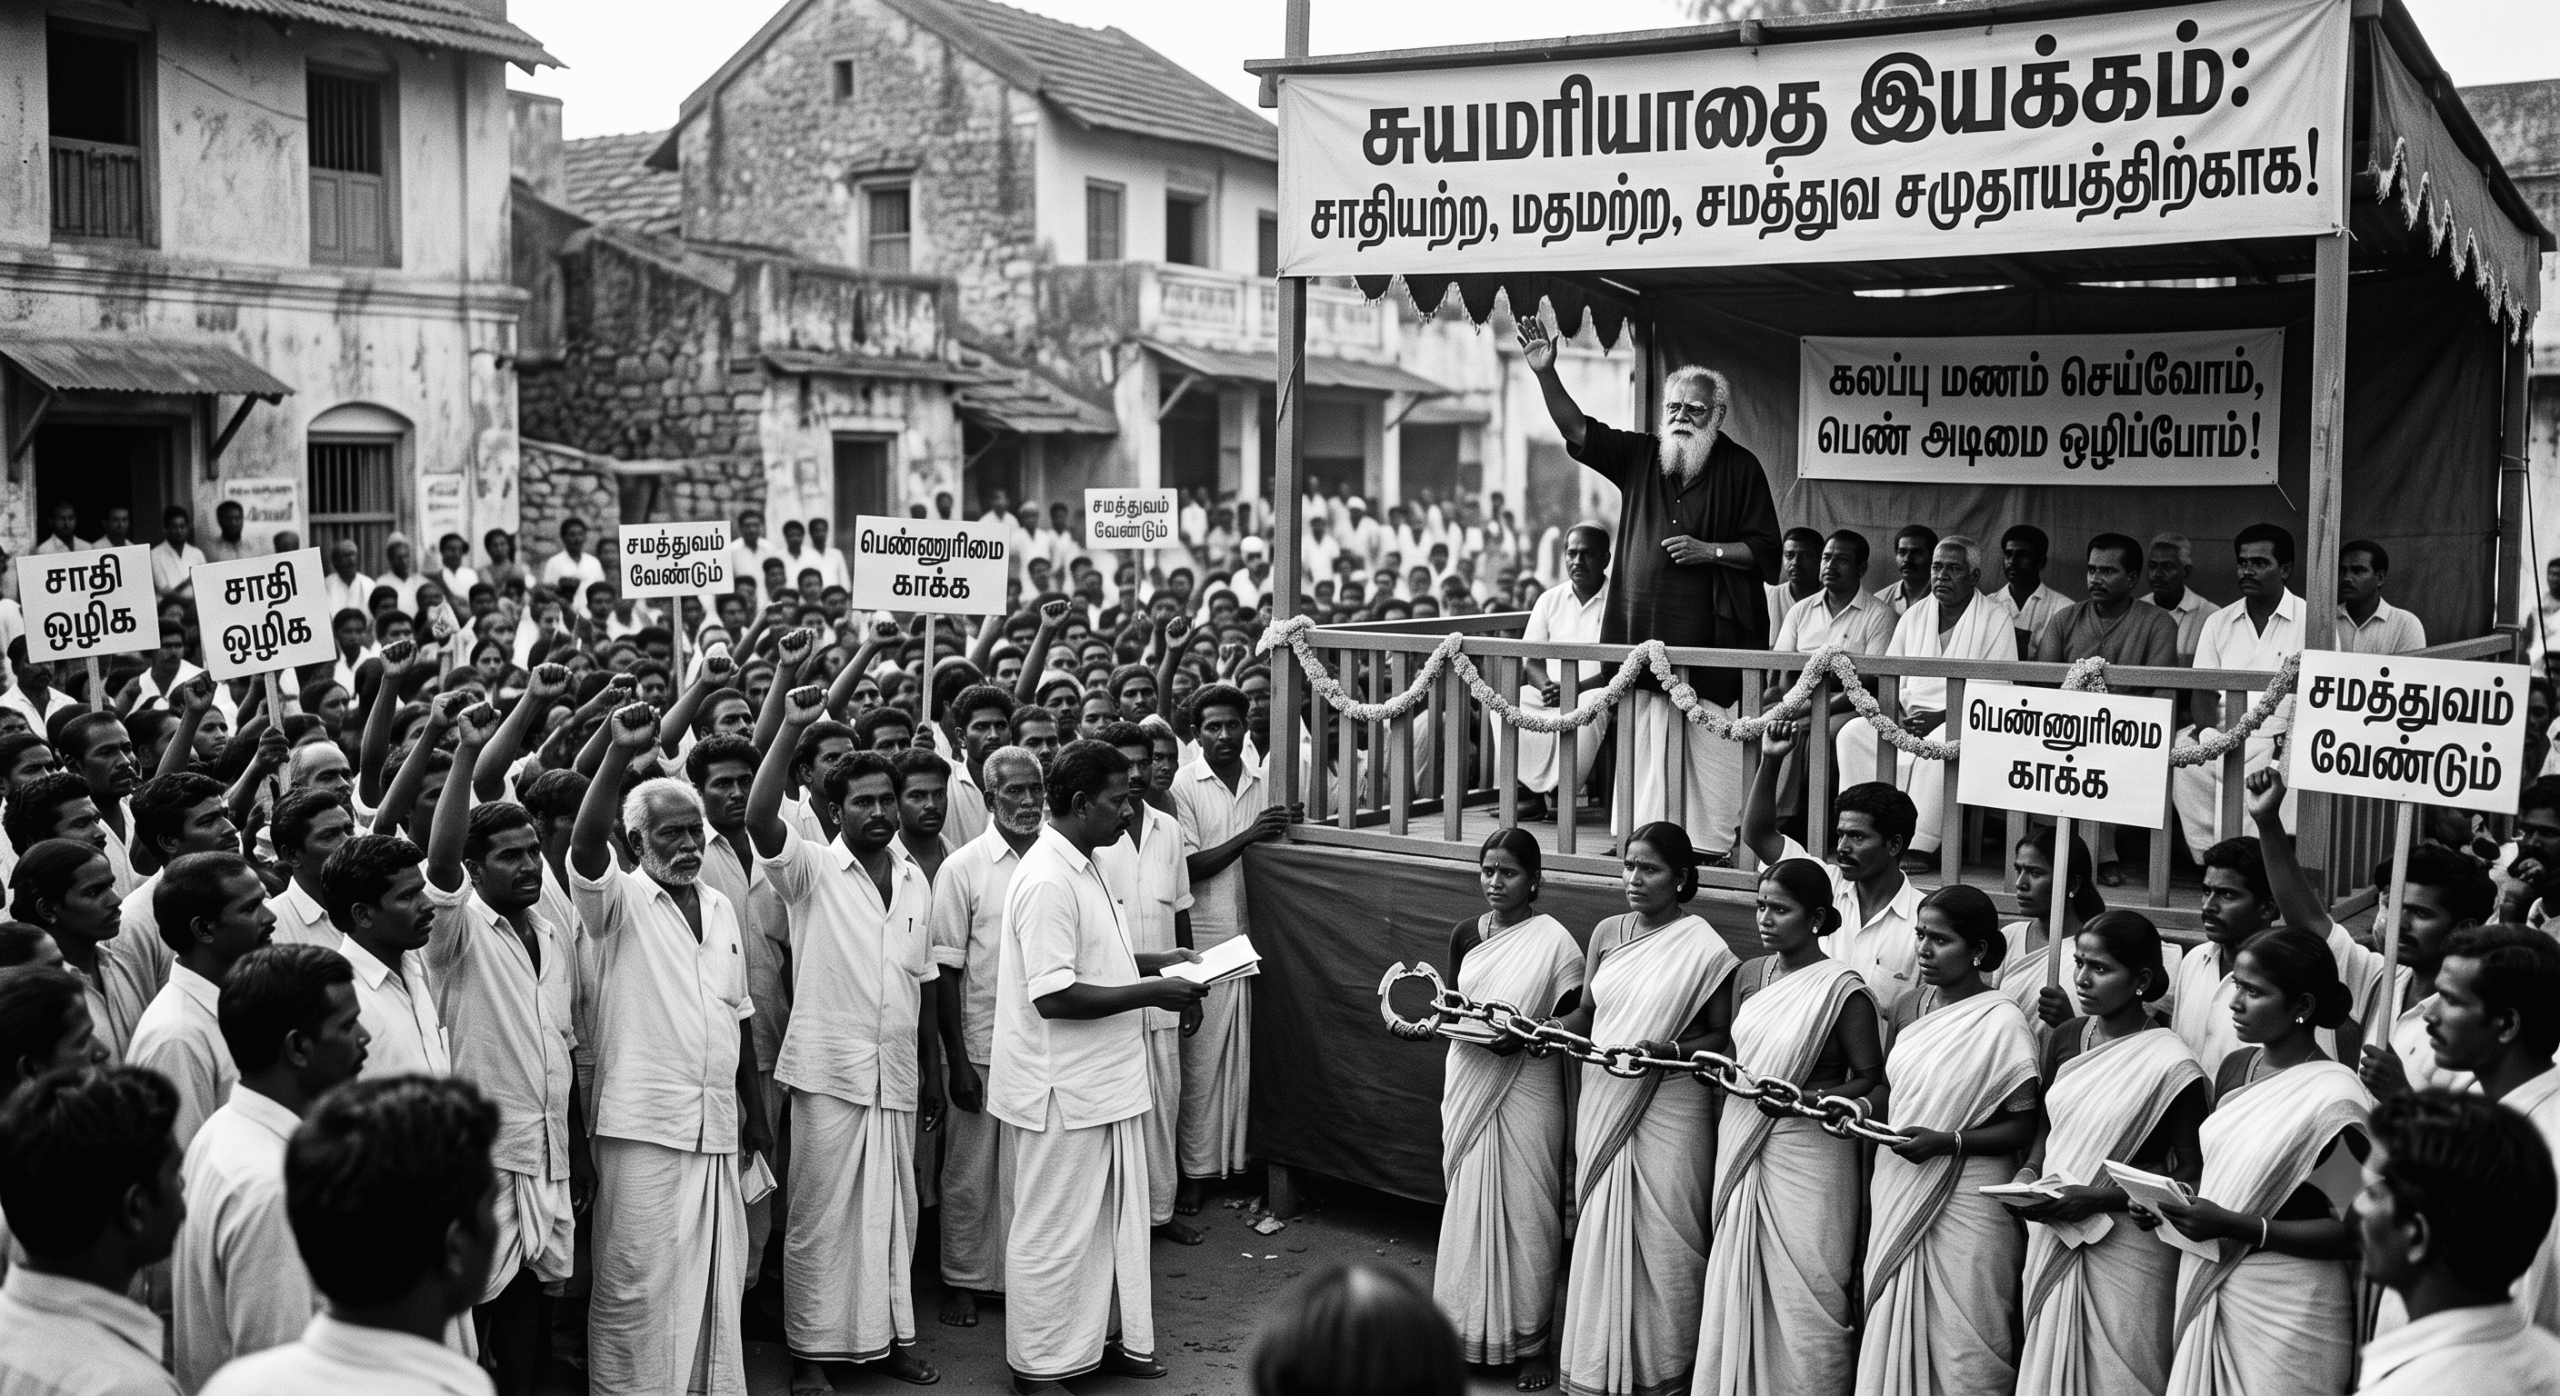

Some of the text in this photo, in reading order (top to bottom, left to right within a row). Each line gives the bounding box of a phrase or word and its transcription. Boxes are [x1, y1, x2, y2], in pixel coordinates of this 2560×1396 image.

[1363, 19, 2249, 166] சுயமரியாதை இயக்கம்:
[1311, 127, 2319, 252] சாதியற்ற, மதமற்ற, சமத்துவ சமுதாயத்திற்காக!
[1829, 346, 2264, 407] கலப்பு மணம் செய்வோம்,
[1818, 410, 2260, 470] பெண் அடிமை ஒழிப்போம்!
[1093, 495, 1169, 519] சமத்துவம்
[1095, 520, 1168, 542] வேண்டும்
[627, 528, 724, 560] சமத்துவம்
[861, 527, 1004, 566] பெண்ணுரிமை
[45, 554, 122, 599] சாதி
[225, 561, 297, 609] சாதி
[630, 559, 723, 588] வேண்டும்
[892, 567, 970, 599] காக்க
[44, 600, 136, 651] ஒழிக
[223, 610, 312, 664] ஒழிக
[2309, 667, 2514, 732] சமத்துவம்
[1970, 699, 2162, 751] பெண்ணுரிமை
[2008, 754, 2108, 799] காக்க
[2311, 729, 2501, 797] வேண்டும்
